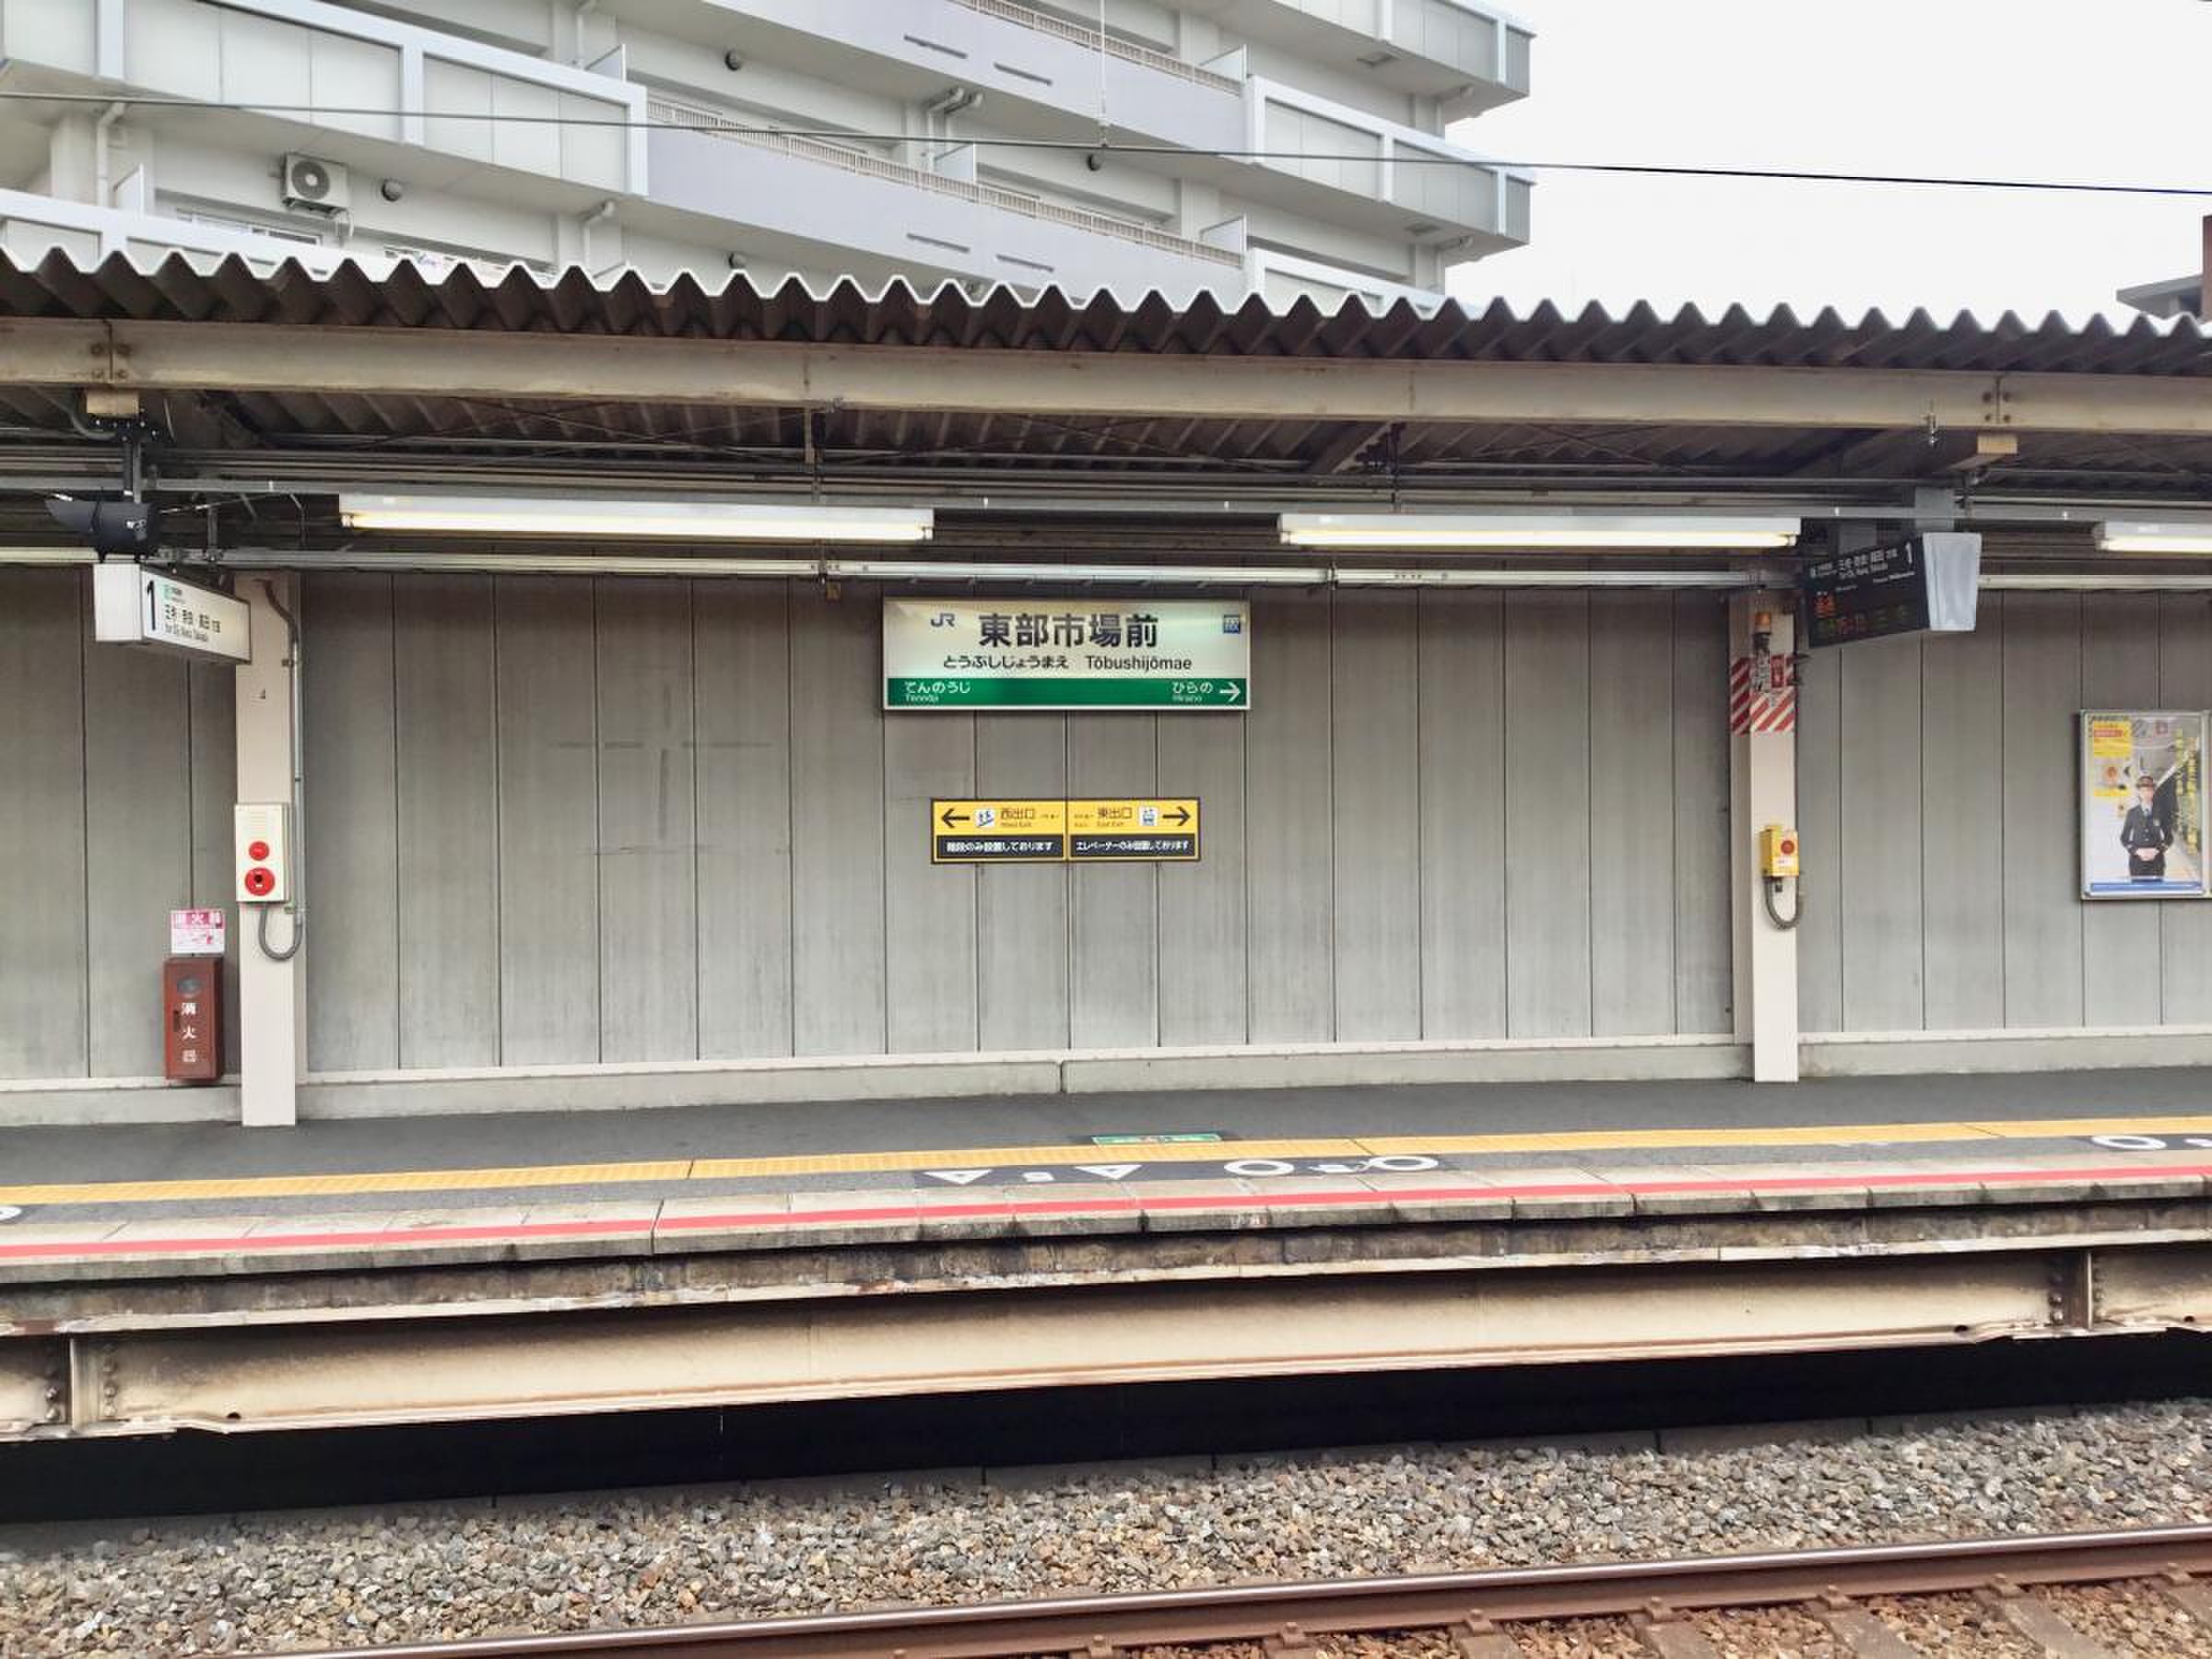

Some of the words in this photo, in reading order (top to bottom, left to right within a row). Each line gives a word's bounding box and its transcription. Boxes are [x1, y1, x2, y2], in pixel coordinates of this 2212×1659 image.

[1904, 541, 1913, 565] 1
[147, 580, 156, 631] 1
[930, 613, 956, 629] JR
[979, 613, 1159, 648] 東部市場前
[943, 655, 1069, 670] とうぶしじょうまえ
[1085, 655, 1193, 675] Tōbushijōmae
[904, 681, 971, 694] てんのうじ
[1171, 681, 1214, 694] ひらの
